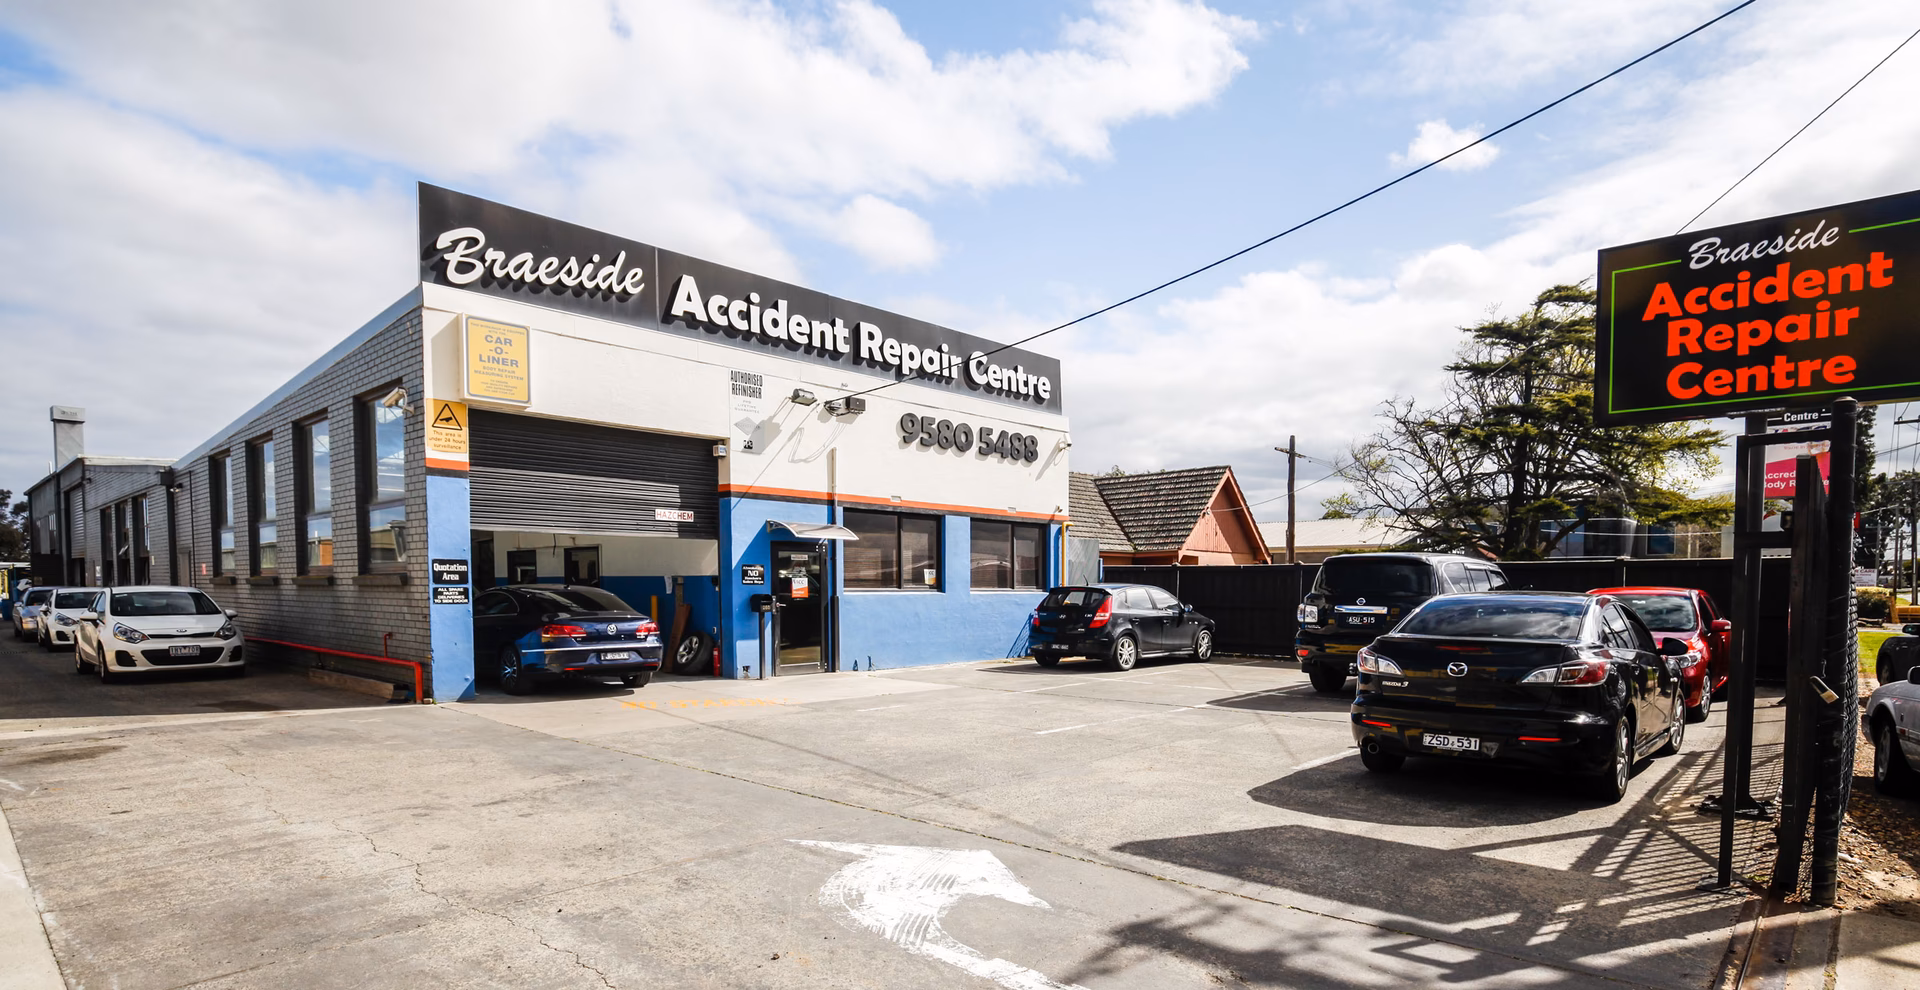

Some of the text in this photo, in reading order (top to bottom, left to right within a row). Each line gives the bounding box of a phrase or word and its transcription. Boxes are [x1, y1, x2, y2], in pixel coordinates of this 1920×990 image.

[1688, 219, 1839, 269] Braeside
[436, 227, 645, 294] Braeside
[1642, 252, 1893, 321] Accident
[671, 274, 1050, 399] Accident Repair Centre
[1667, 300, 1859, 357] Repair
[484, 334, 512, 346] CAR
[489, 346, 509, 355] -O-
[479, 354, 519, 368] LINER
[730, 370, 763, 386] AUTHORISED
[1666, 355, 1857, 400] Centre
[732, 383, 762, 399] REFINISHER
[1783, 412, 1819, 422] Centre
[901, 413, 1038, 463] 9580 5488
[1765, 470, 1797, 479] ccred
[656, 511, 693, 520] HAZCHEM
[434, 563, 467, 571] Quotation
[1428, 735, 1450, 747] ZSD
[1456, 737, 1478, 750] 531
